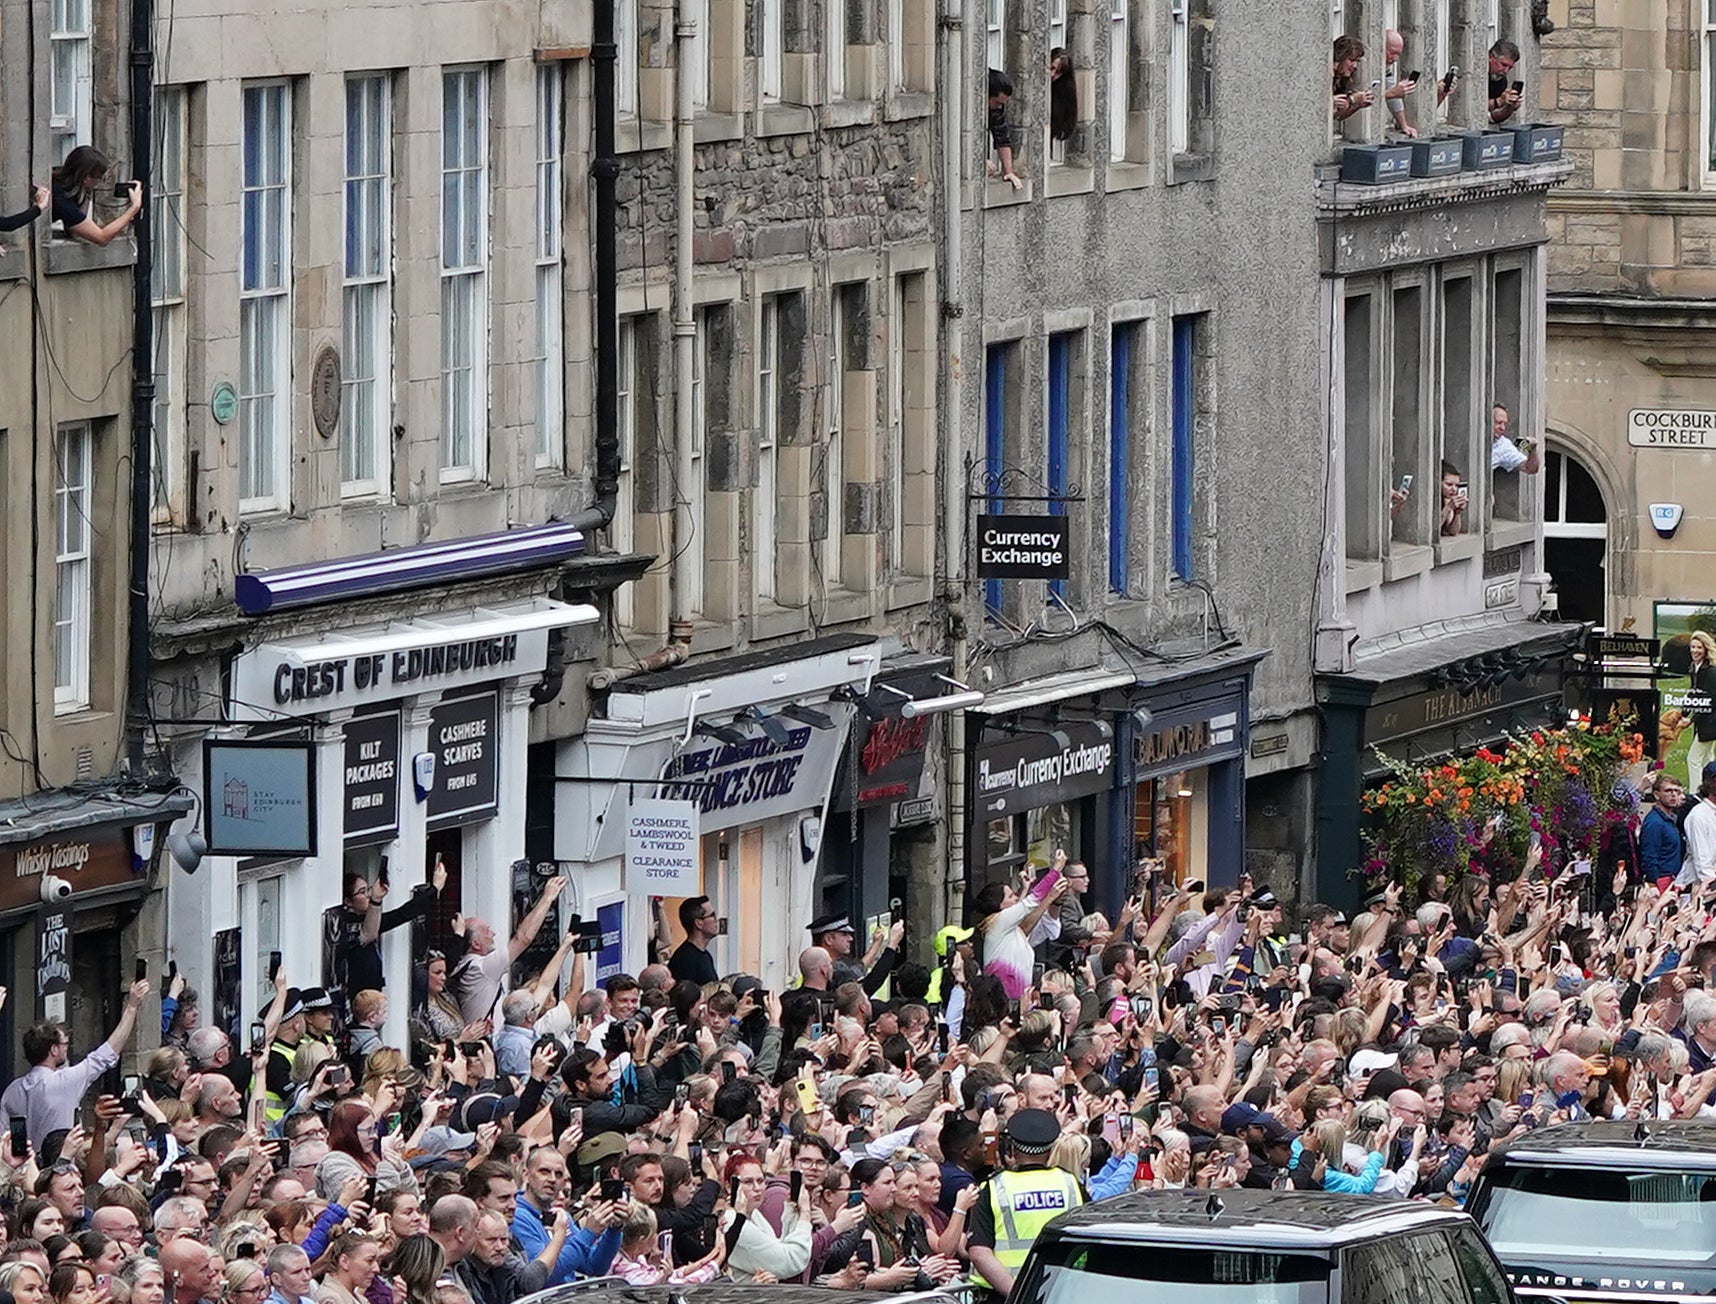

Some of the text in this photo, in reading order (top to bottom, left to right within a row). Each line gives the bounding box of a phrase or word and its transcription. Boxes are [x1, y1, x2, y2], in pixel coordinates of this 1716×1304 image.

[1649, 429, 1707, 445] STREET
[984, 529, 1061, 548] Currency
[981, 548, 1062, 567] Exchange
[274, 634, 518, 705] CREST OF EDINBURGH
[1424, 694, 1446, 722] THE
[1663, 693, 1713, 707] Barbour
[440, 719, 487, 745] CASHMERE
[360, 740, 382, 761] KILT
[443, 742, 483, 766] SCARVES
[346, 761, 395, 785] PACKAGES
[1017, 742, 1112, 788] Currency Exchange
[744, 754, 804, 804] STORE
[632, 817, 691, 831] CASHMERE,
[629, 829, 694, 841] LAMBSWOOL
[640, 841, 685, 851] & TWEED
[16, 841, 90, 878] Whisky Tastings
[632, 856, 693, 868] CLEARANCE
[646, 867, 680, 879] STORE
[45, 912, 64, 931] THE
[41, 927, 69, 961] LOST
[1014, 1190, 1065, 1211] POLICE
[1507, 1273, 1685, 1291] RANGE ROVER
